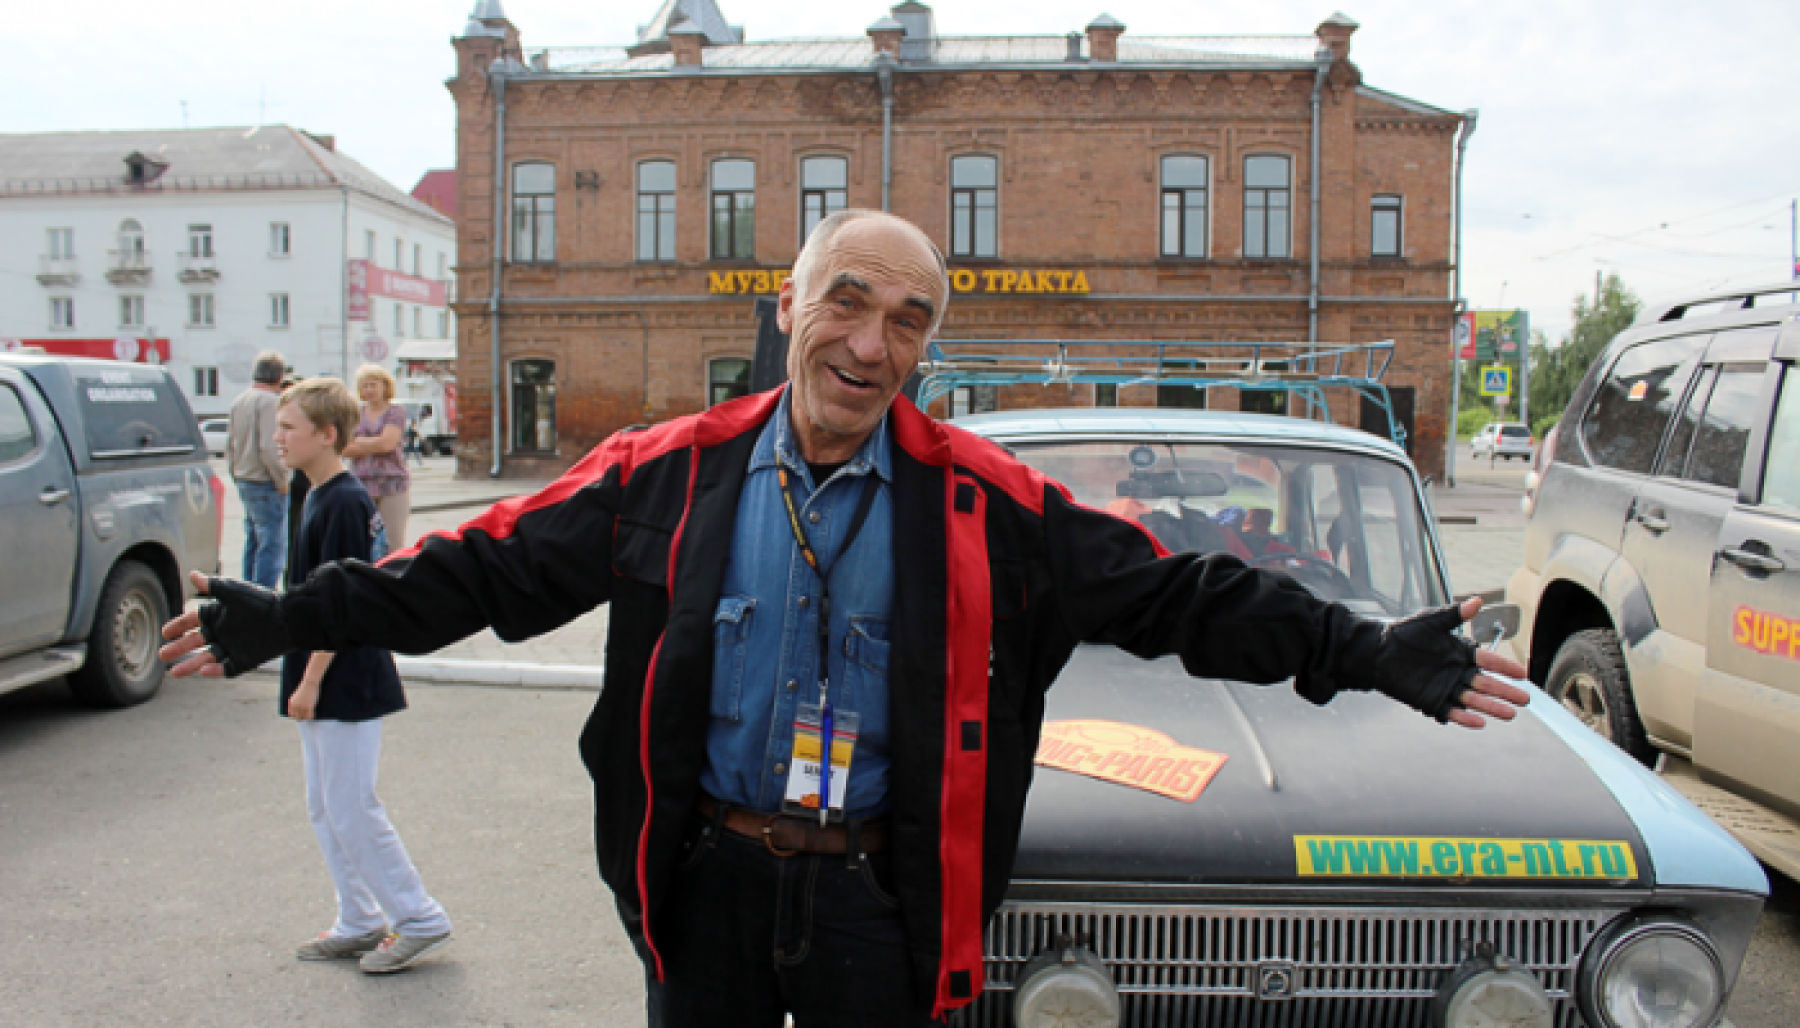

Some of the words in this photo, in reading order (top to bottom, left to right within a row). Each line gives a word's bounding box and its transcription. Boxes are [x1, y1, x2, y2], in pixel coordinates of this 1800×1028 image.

[709, 270, 792, 296] МУЗЕ
[982, 269, 1091, 294] ТРАКТА
[1305, 840, 1629, 878] www.era-nt.ru
